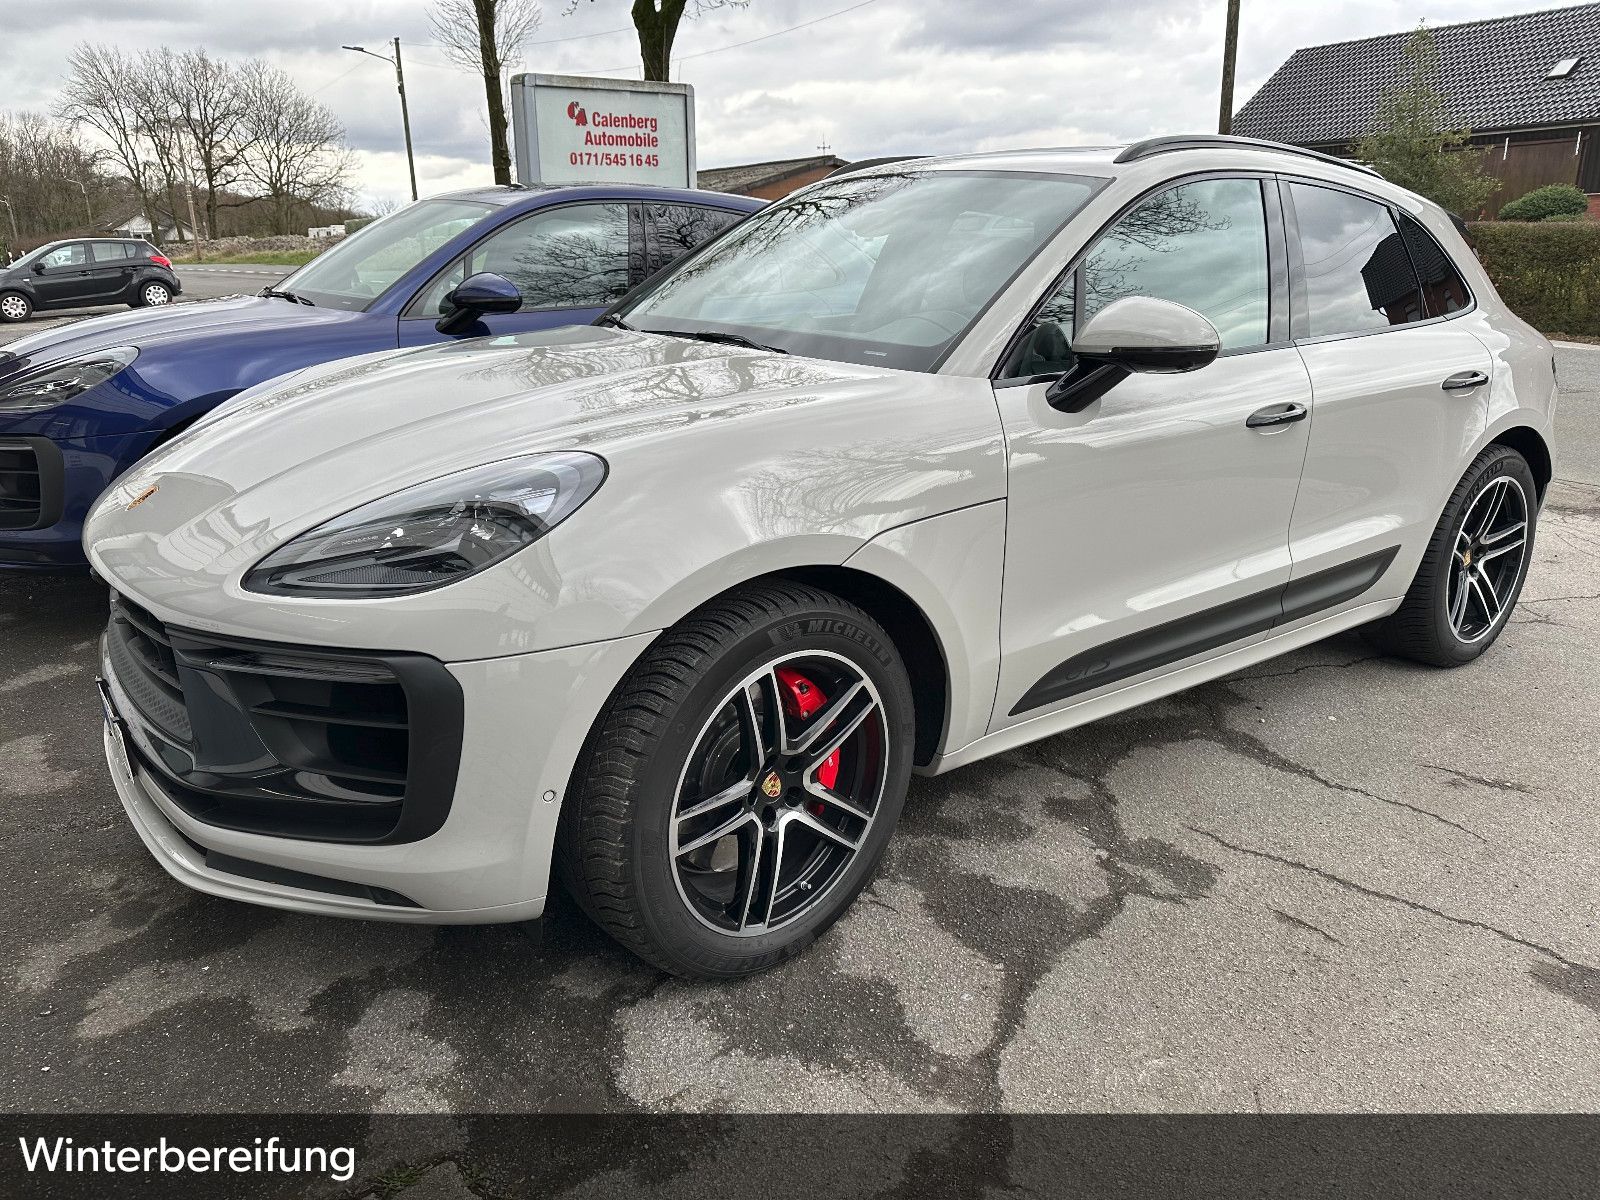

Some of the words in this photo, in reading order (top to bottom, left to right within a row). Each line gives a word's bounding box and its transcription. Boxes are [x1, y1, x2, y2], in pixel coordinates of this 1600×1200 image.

[592, 111, 658, 132] Calenberg
[584, 131, 659, 148] Automobile
[807, 620, 891, 663] MICHELIN
